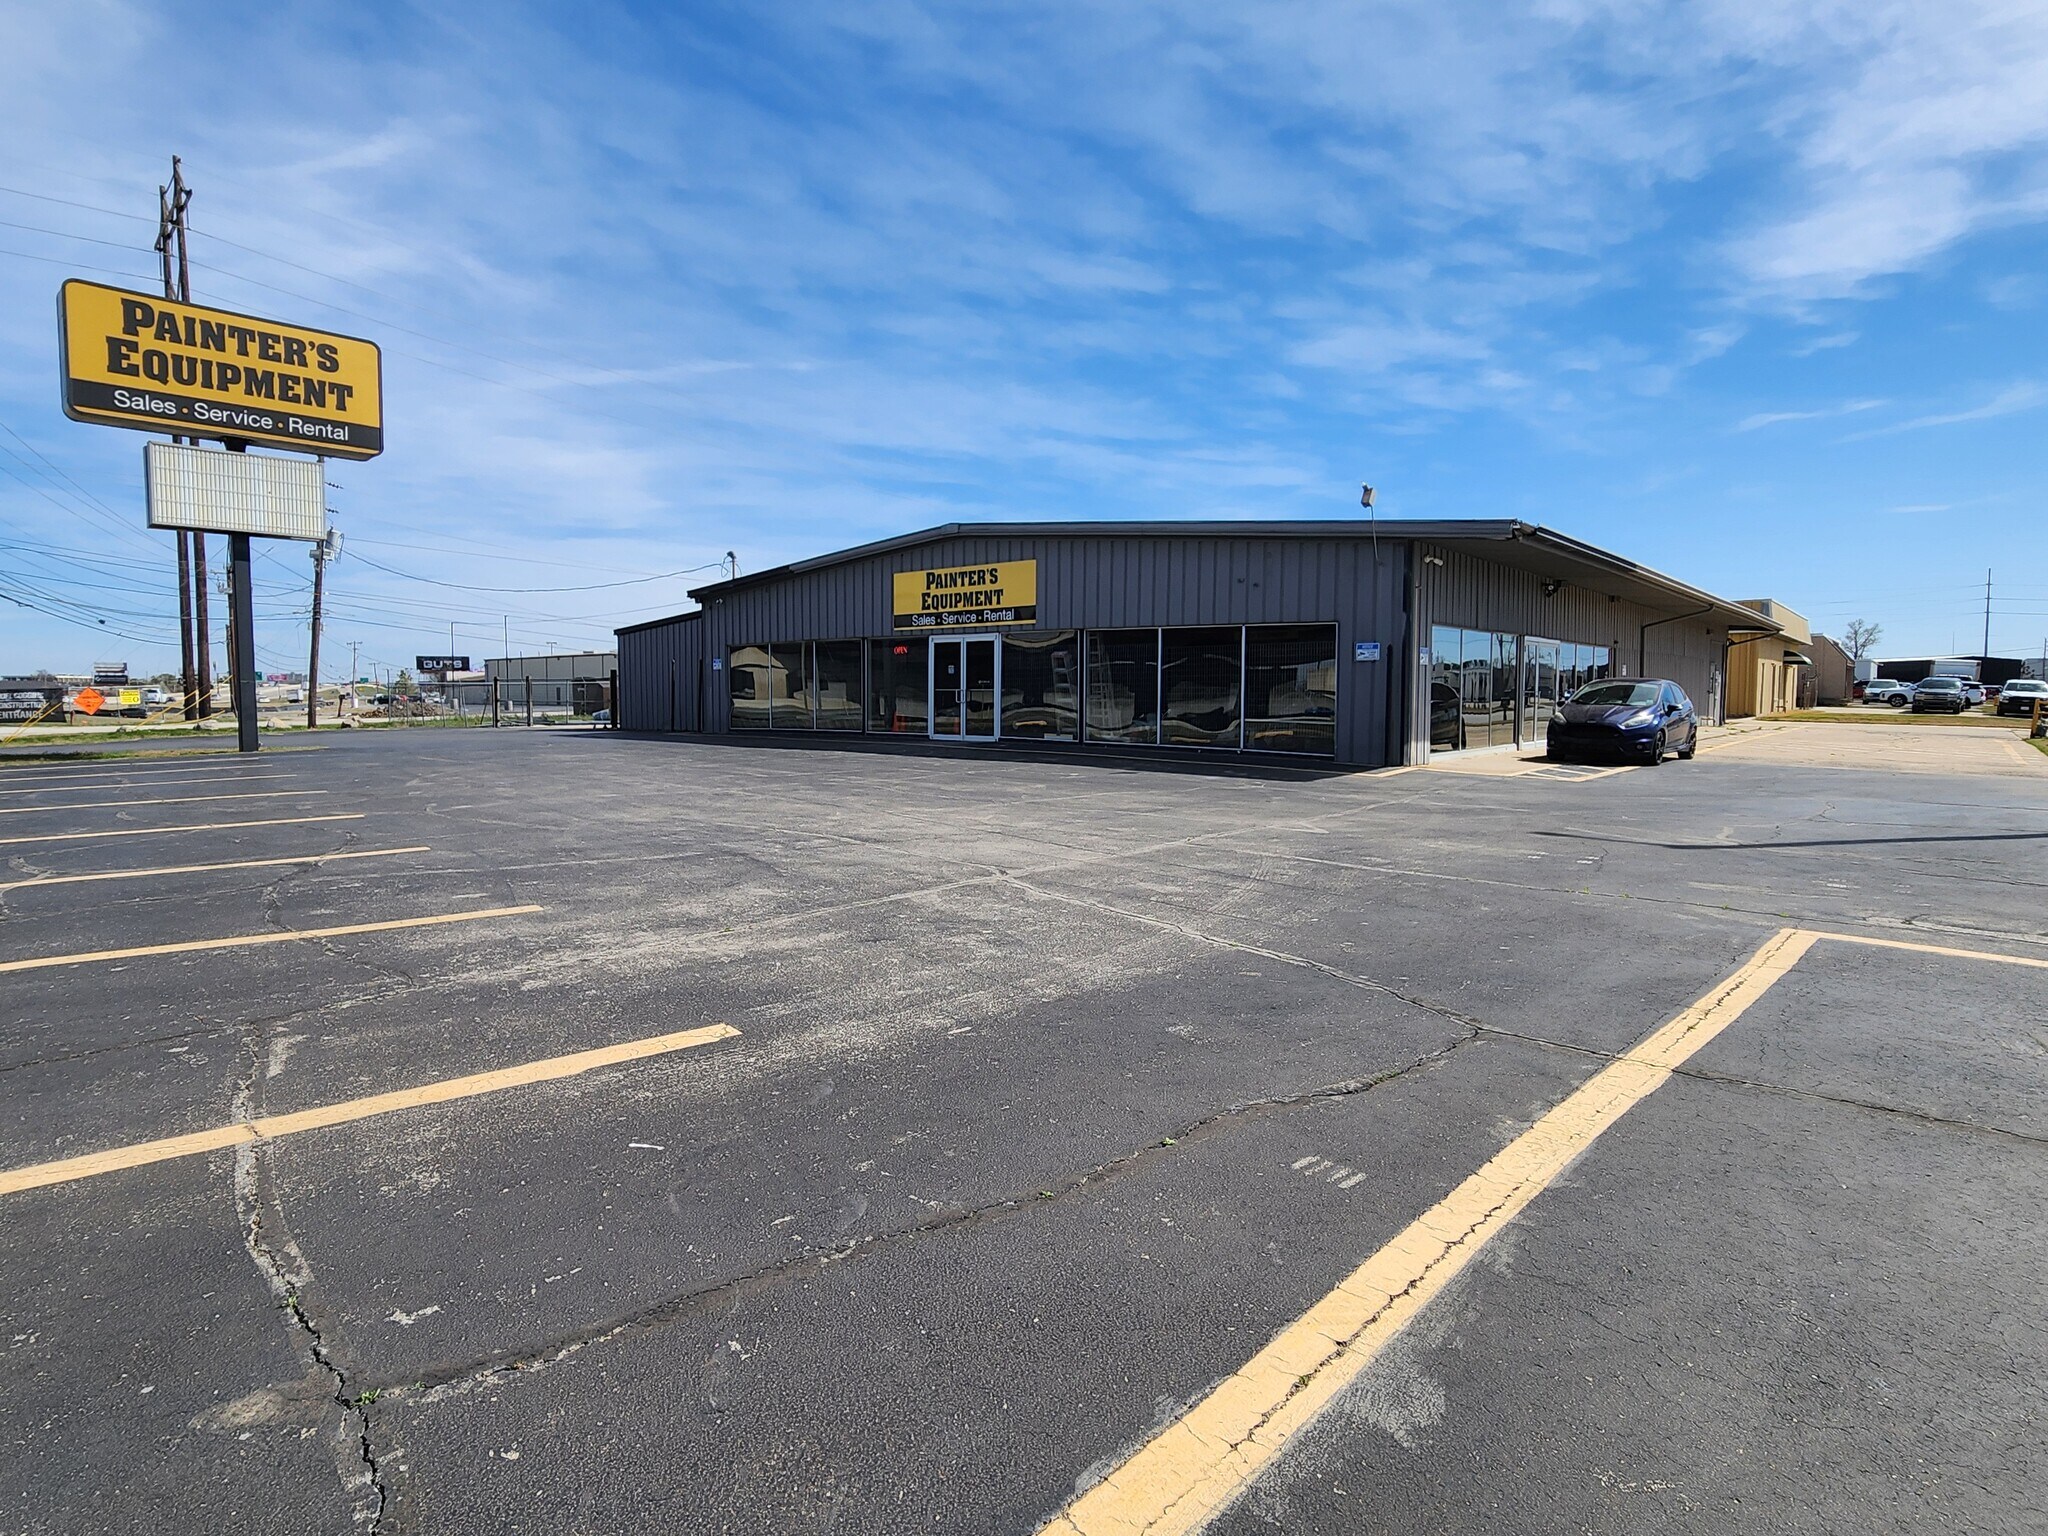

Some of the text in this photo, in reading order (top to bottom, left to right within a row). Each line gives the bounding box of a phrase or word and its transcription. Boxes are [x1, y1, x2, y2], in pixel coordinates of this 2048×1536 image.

[121, 297, 340, 373] PAINTER'S
[105, 335, 354, 412] EQUIPMENT
[113, 390, 349, 441] Sales Service Rental
[926, 568, 998, 590] PAINTER'S
[912, 609, 1015, 626] Sales Service Rental
[921, 588, 1004, 611] EQUIPMENT
